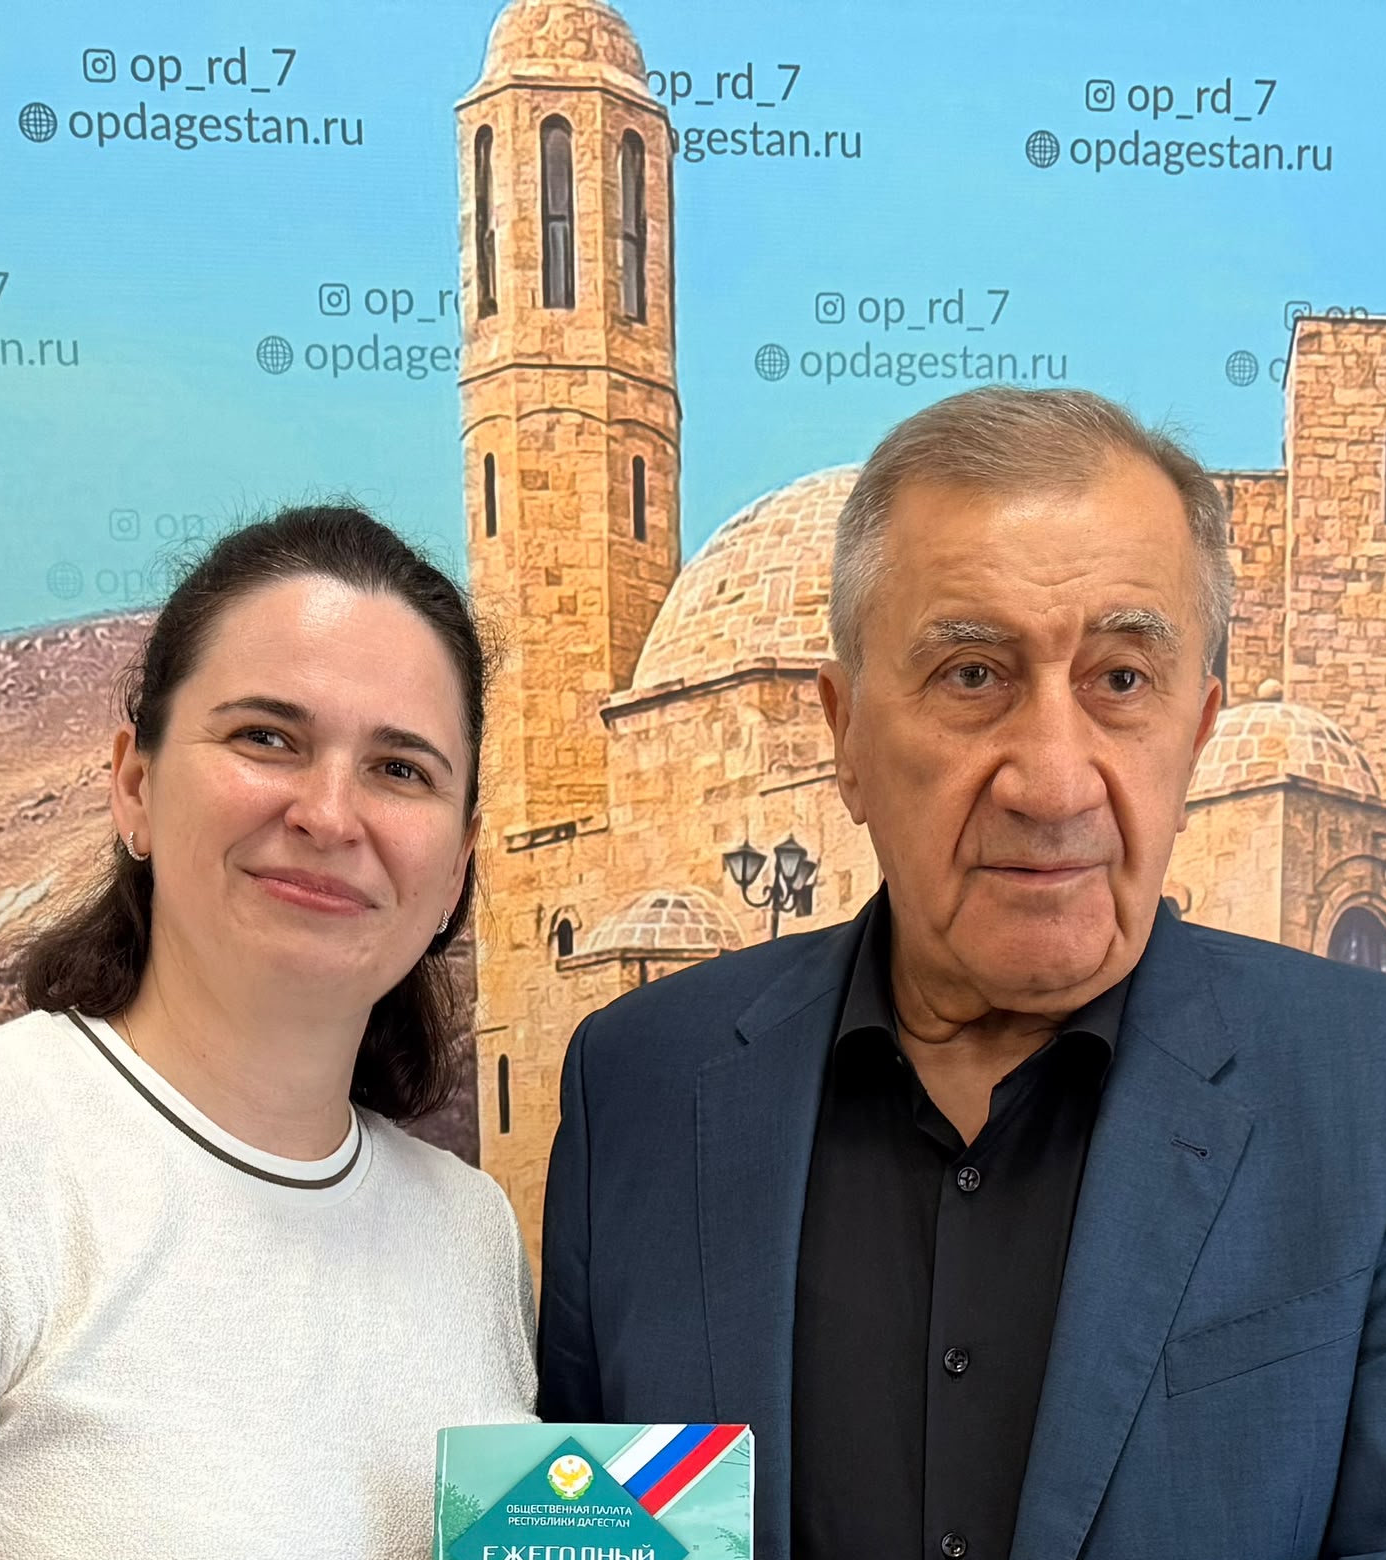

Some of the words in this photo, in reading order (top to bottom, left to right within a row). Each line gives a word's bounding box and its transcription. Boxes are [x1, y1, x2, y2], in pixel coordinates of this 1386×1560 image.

[130, 46, 297, 93] op_rd_7
[646, 62, 801, 107] op_rd_7
[1127, 78, 1277, 121] op_rd_7
[69, 102, 363, 150] opdagestan.ru
[1069, 130, 1333, 175] opdagestan.ru
[858, 288, 1010, 331] op_rd_7
[800, 343, 1067, 381] opdagestan.ru
[506, 1504, 590, 1515] ОБЩЕСТВЕННАЯ
[592, 1505, 633, 1516] ПАЛАТА
[508, 1516, 575, 1527] РЕСПУБЛИКИ
[577, 1518, 630, 1528] ДАГЕСТАН
